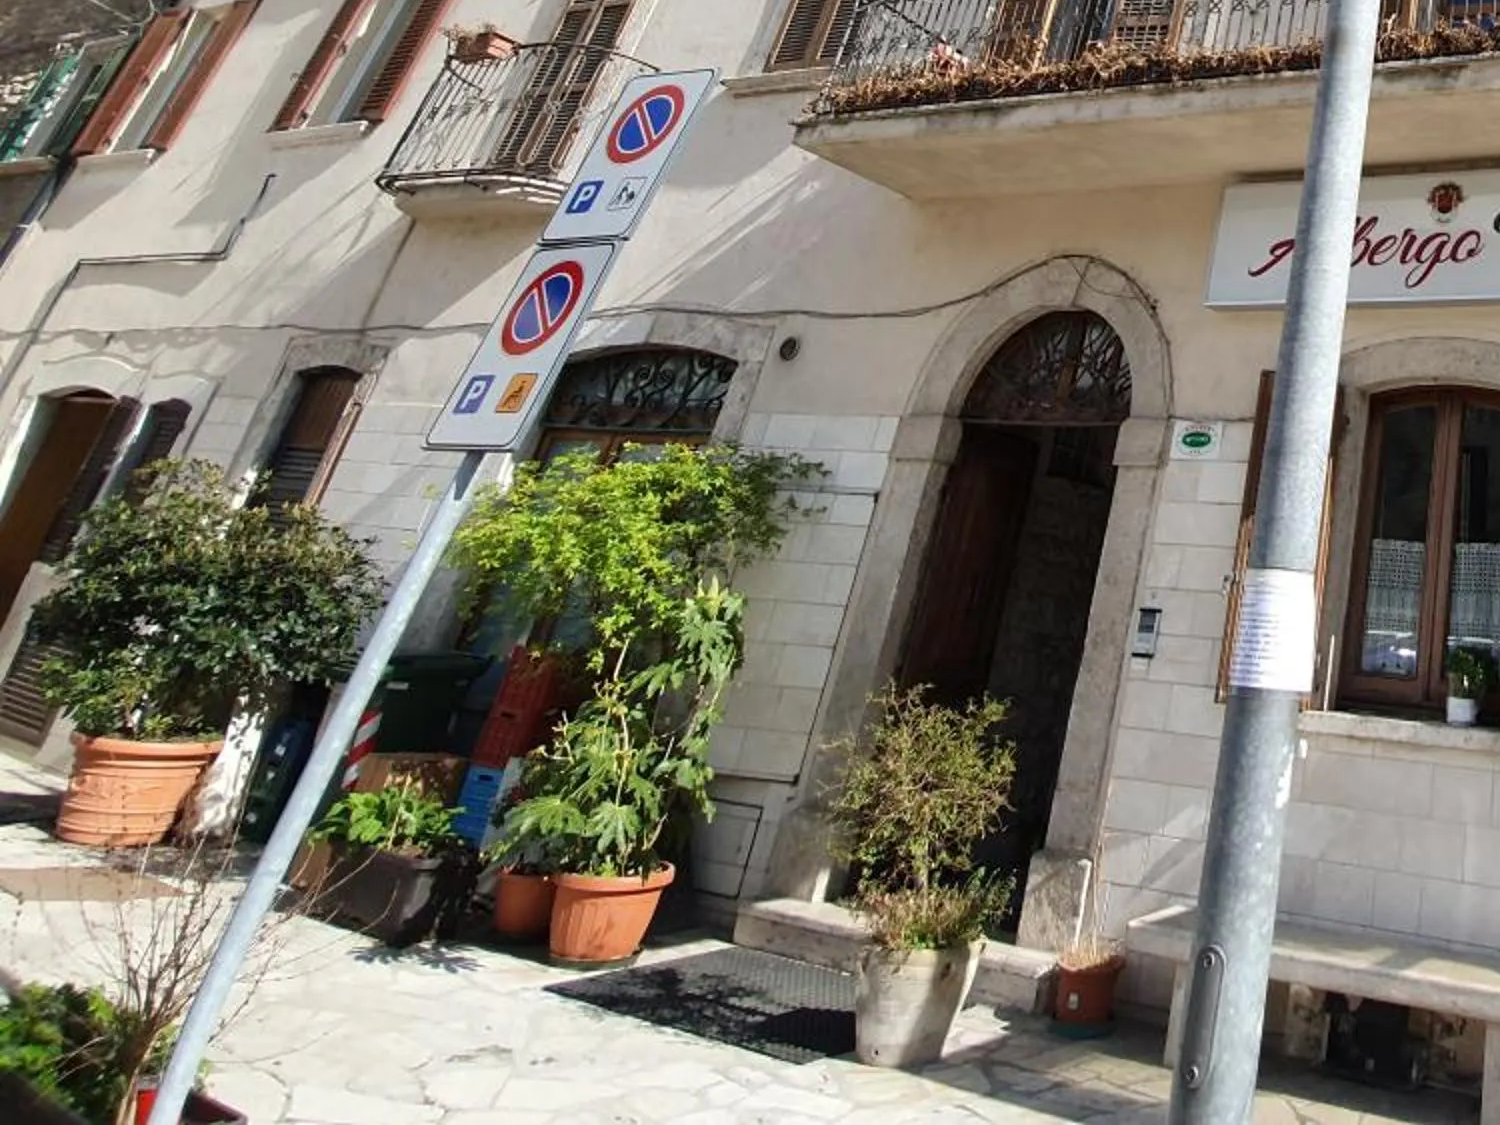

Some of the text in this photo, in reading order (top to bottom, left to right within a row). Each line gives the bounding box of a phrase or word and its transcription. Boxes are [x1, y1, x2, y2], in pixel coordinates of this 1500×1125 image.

[572, 187, 596, 210] P
[1247, 216, 1484, 289] bergo
[466, 383, 487, 407] P
